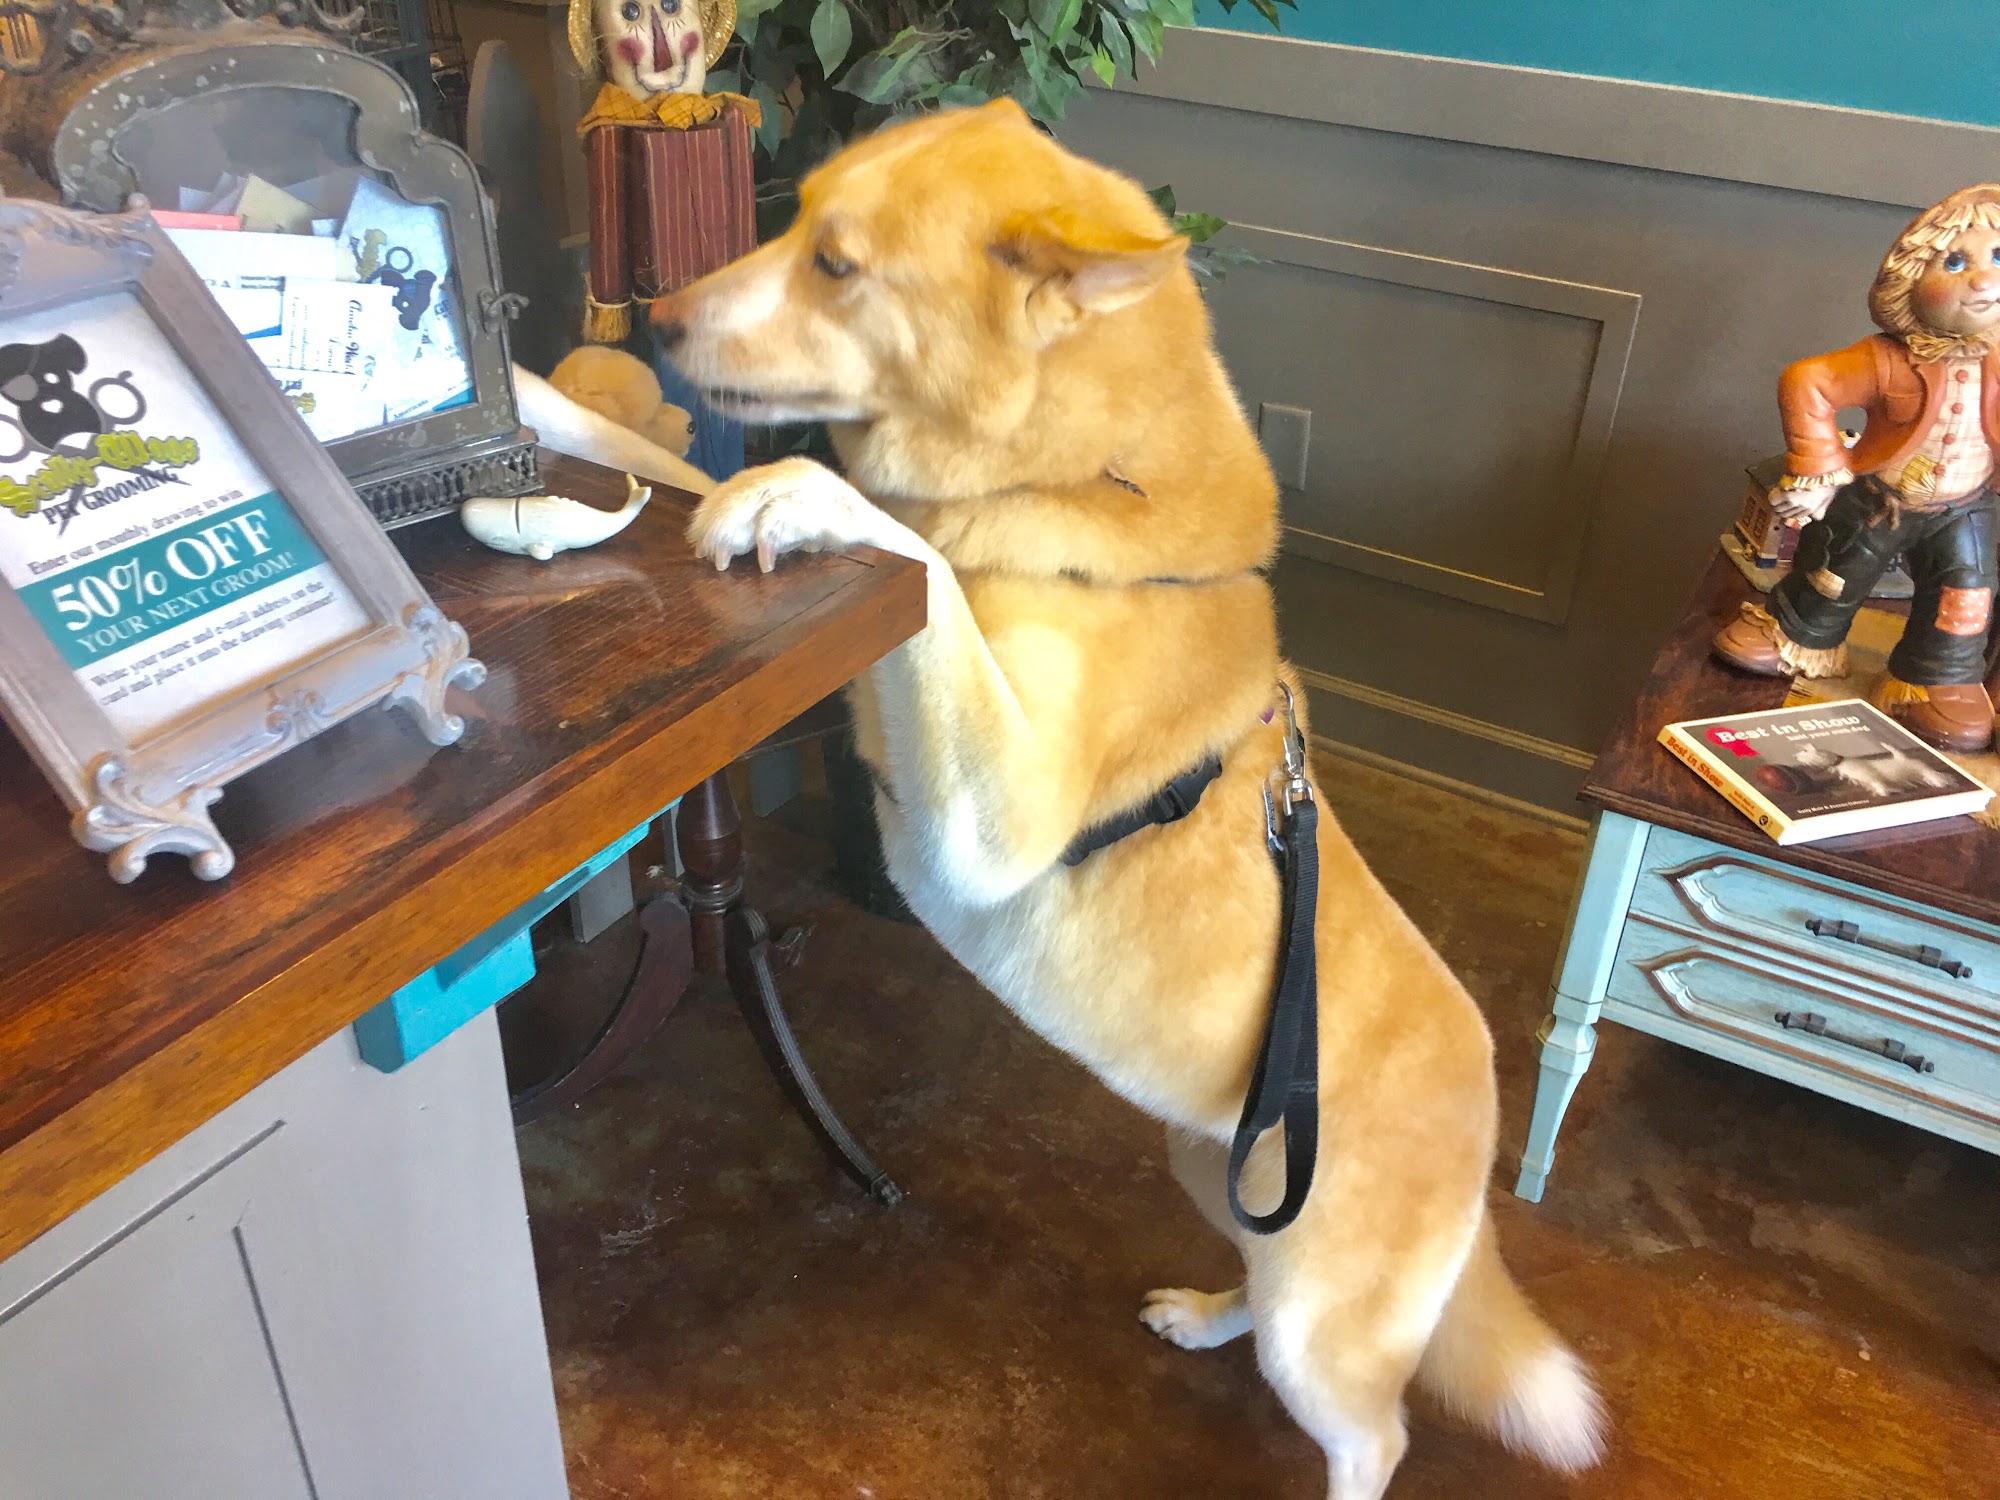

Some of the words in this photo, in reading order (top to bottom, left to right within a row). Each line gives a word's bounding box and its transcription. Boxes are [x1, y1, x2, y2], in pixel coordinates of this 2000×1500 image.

[42, 500, 80, 525] PET
[82, 467, 179, 510] GROOMING
[70, 545, 94, 560] our
[95, 525, 150, 551] monthly
[151, 504, 204, 529] drawing
[218, 489, 243, 502] win
[51, 557, 168, 631] 50%
[166, 509, 272, 580] OFF
[76, 615, 150, 653] YOUR
[147, 587, 210, 625] NEXT
[210, 551, 298, 597] GROOM!
[129, 654, 158, 675] your
[159, 640, 192, 659] name
[192, 627, 214, 644] and
[252, 596, 291, 618] address
[291, 589, 306, 600] on
[306, 581, 324, 593] the
[129, 674, 153, 693] and
[153, 662, 185, 685] place
[220, 638, 239, 651] the
[240, 618, 286, 642] drawing
[1667, 736, 1688, 757] Best
[1687, 754, 1698, 766] in
[1698, 763, 1723, 787] Show
[1715, 726, 1770, 743] Best
[1771, 724, 1799, 735] in
[1799, 715, 1860, 731] Show
[1809, 731, 1830, 741] your
[1850, 725, 1871, 733] dog
